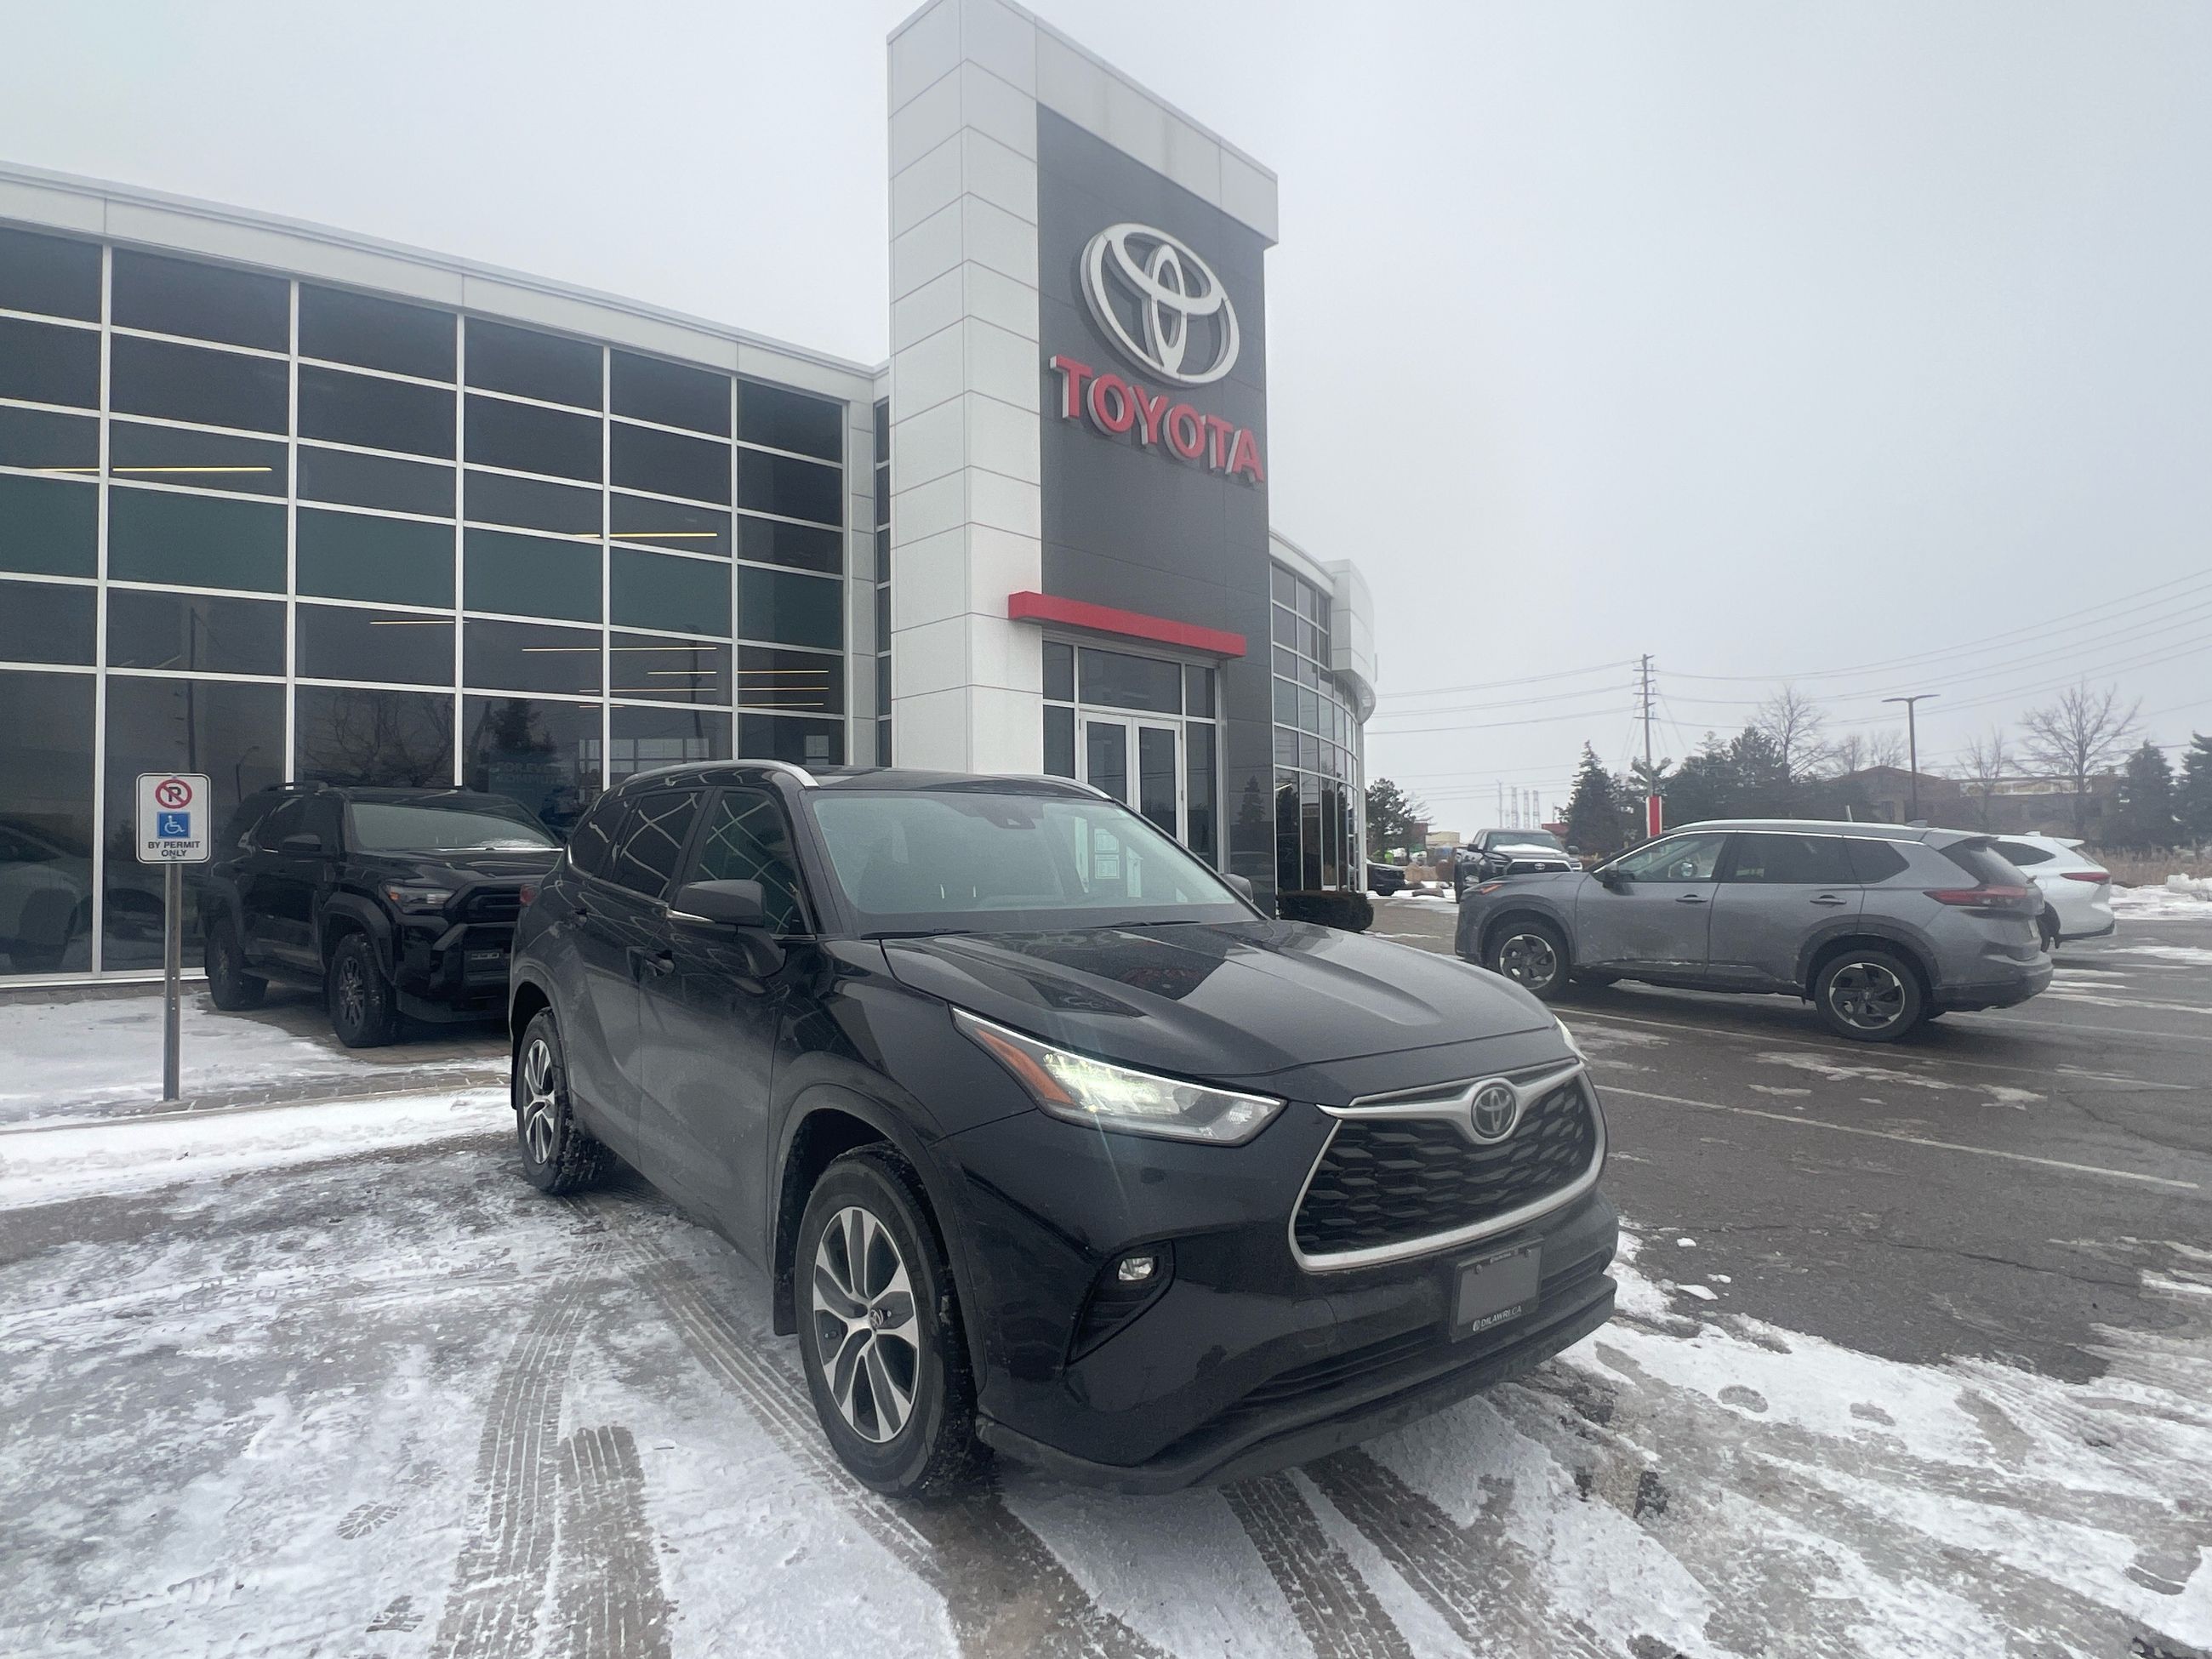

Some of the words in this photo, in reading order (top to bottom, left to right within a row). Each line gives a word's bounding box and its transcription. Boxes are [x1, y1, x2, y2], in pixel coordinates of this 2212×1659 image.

[1050, 354, 1264, 482] TOYOTA
[147, 841, 161, 849] BY
[163, 841, 201, 849] PERMIT
